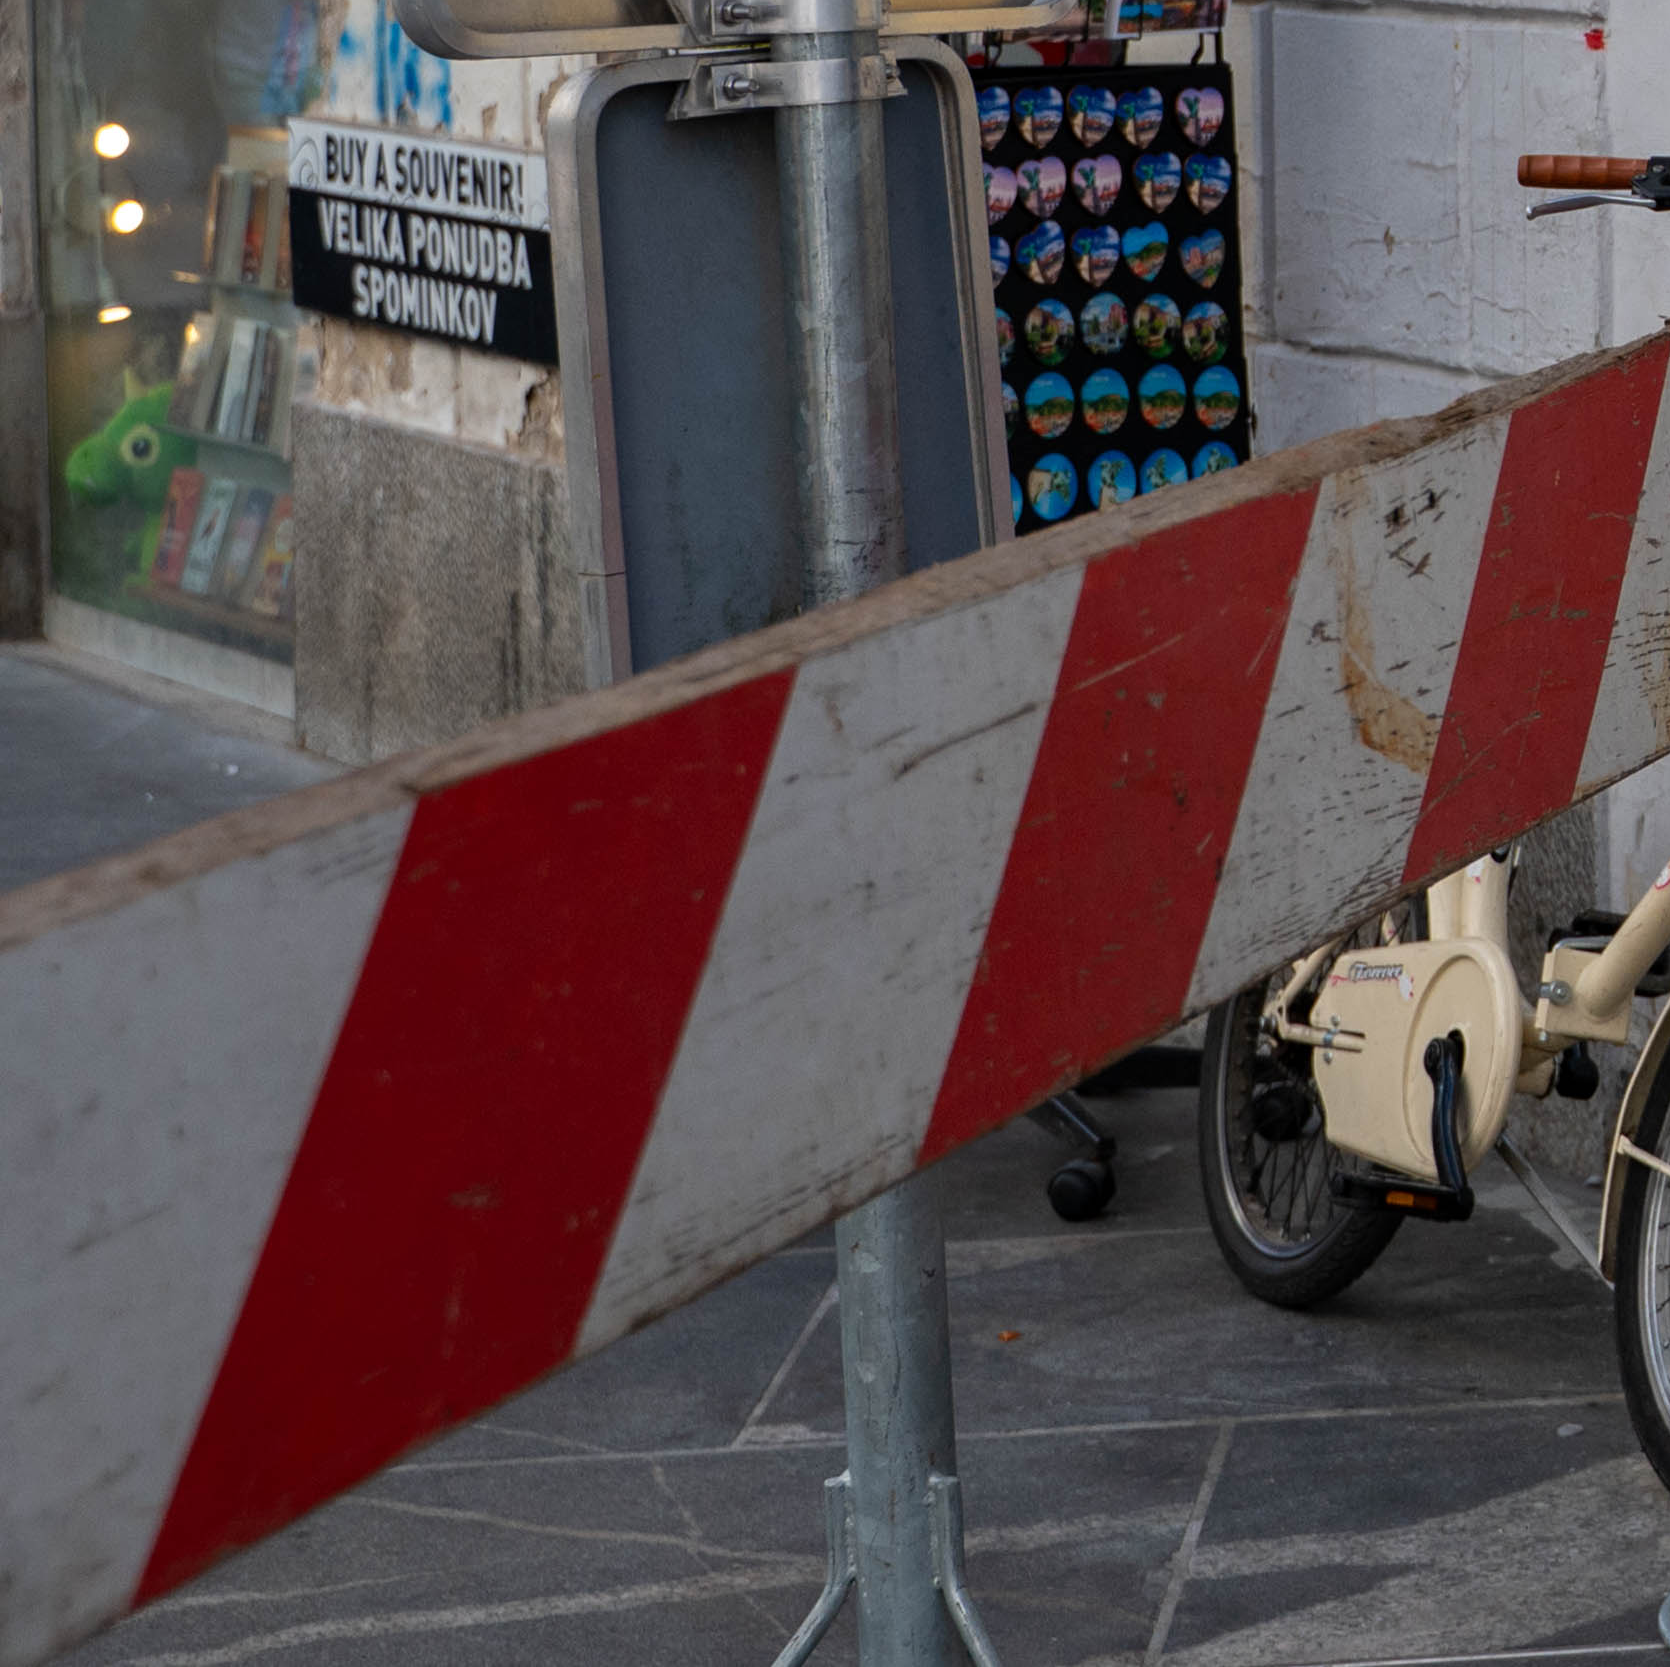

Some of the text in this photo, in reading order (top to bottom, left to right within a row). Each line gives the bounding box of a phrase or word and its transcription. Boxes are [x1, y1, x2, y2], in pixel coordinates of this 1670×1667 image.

[326, 135, 525, 214] BUY A SOUVENIR!
[319, 197, 533, 290] VELIKA PONUDBA
[352, 263, 498, 345] SPOMINKOV
